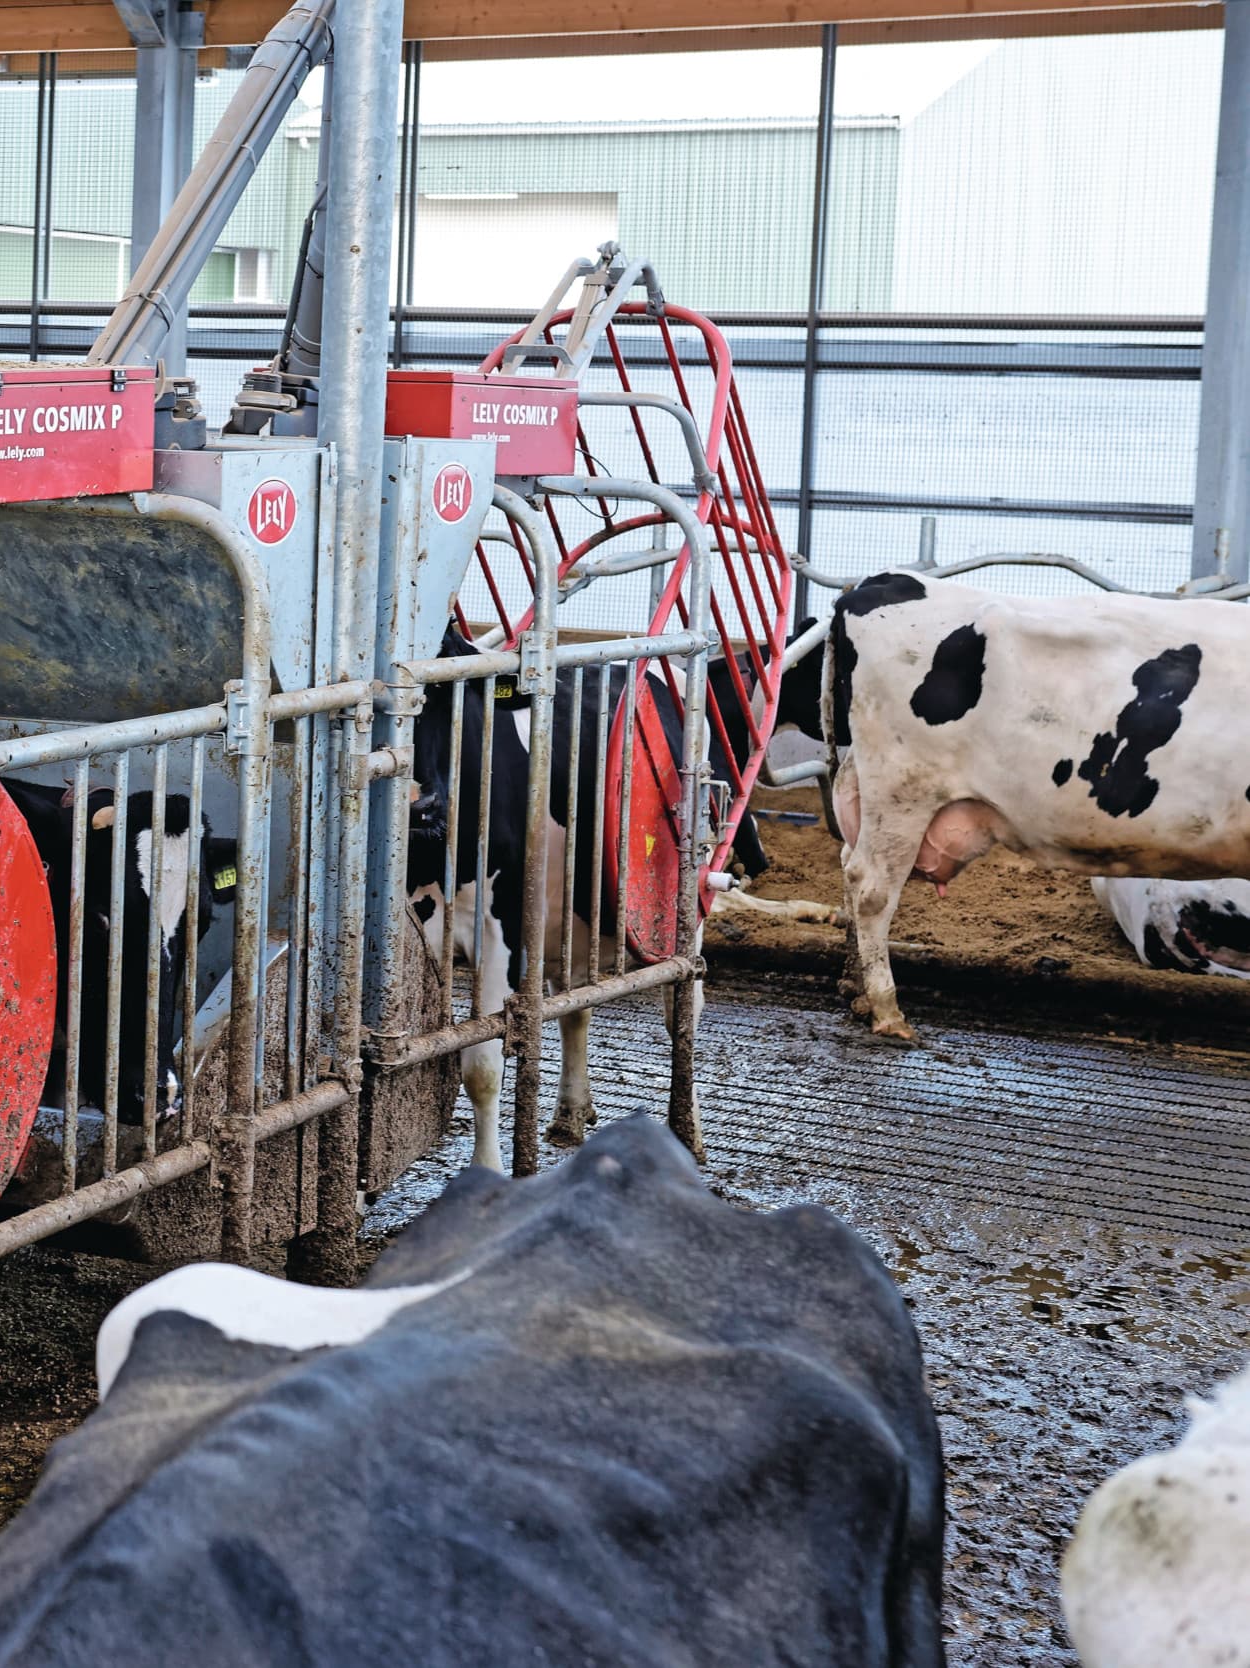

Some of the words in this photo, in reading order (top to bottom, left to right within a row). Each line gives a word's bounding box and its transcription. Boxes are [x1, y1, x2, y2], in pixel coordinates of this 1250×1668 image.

[32, 404, 106, 433] COSMIX
[111, 403, 123, 429] P
[473, 402, 501, 424] LELY
[503, 403, 549, 426] COSMIX
[550, 406, 559, 426] P
[440, 472, 467, 513] LELY
[256, 489, 288, 535] LELY
